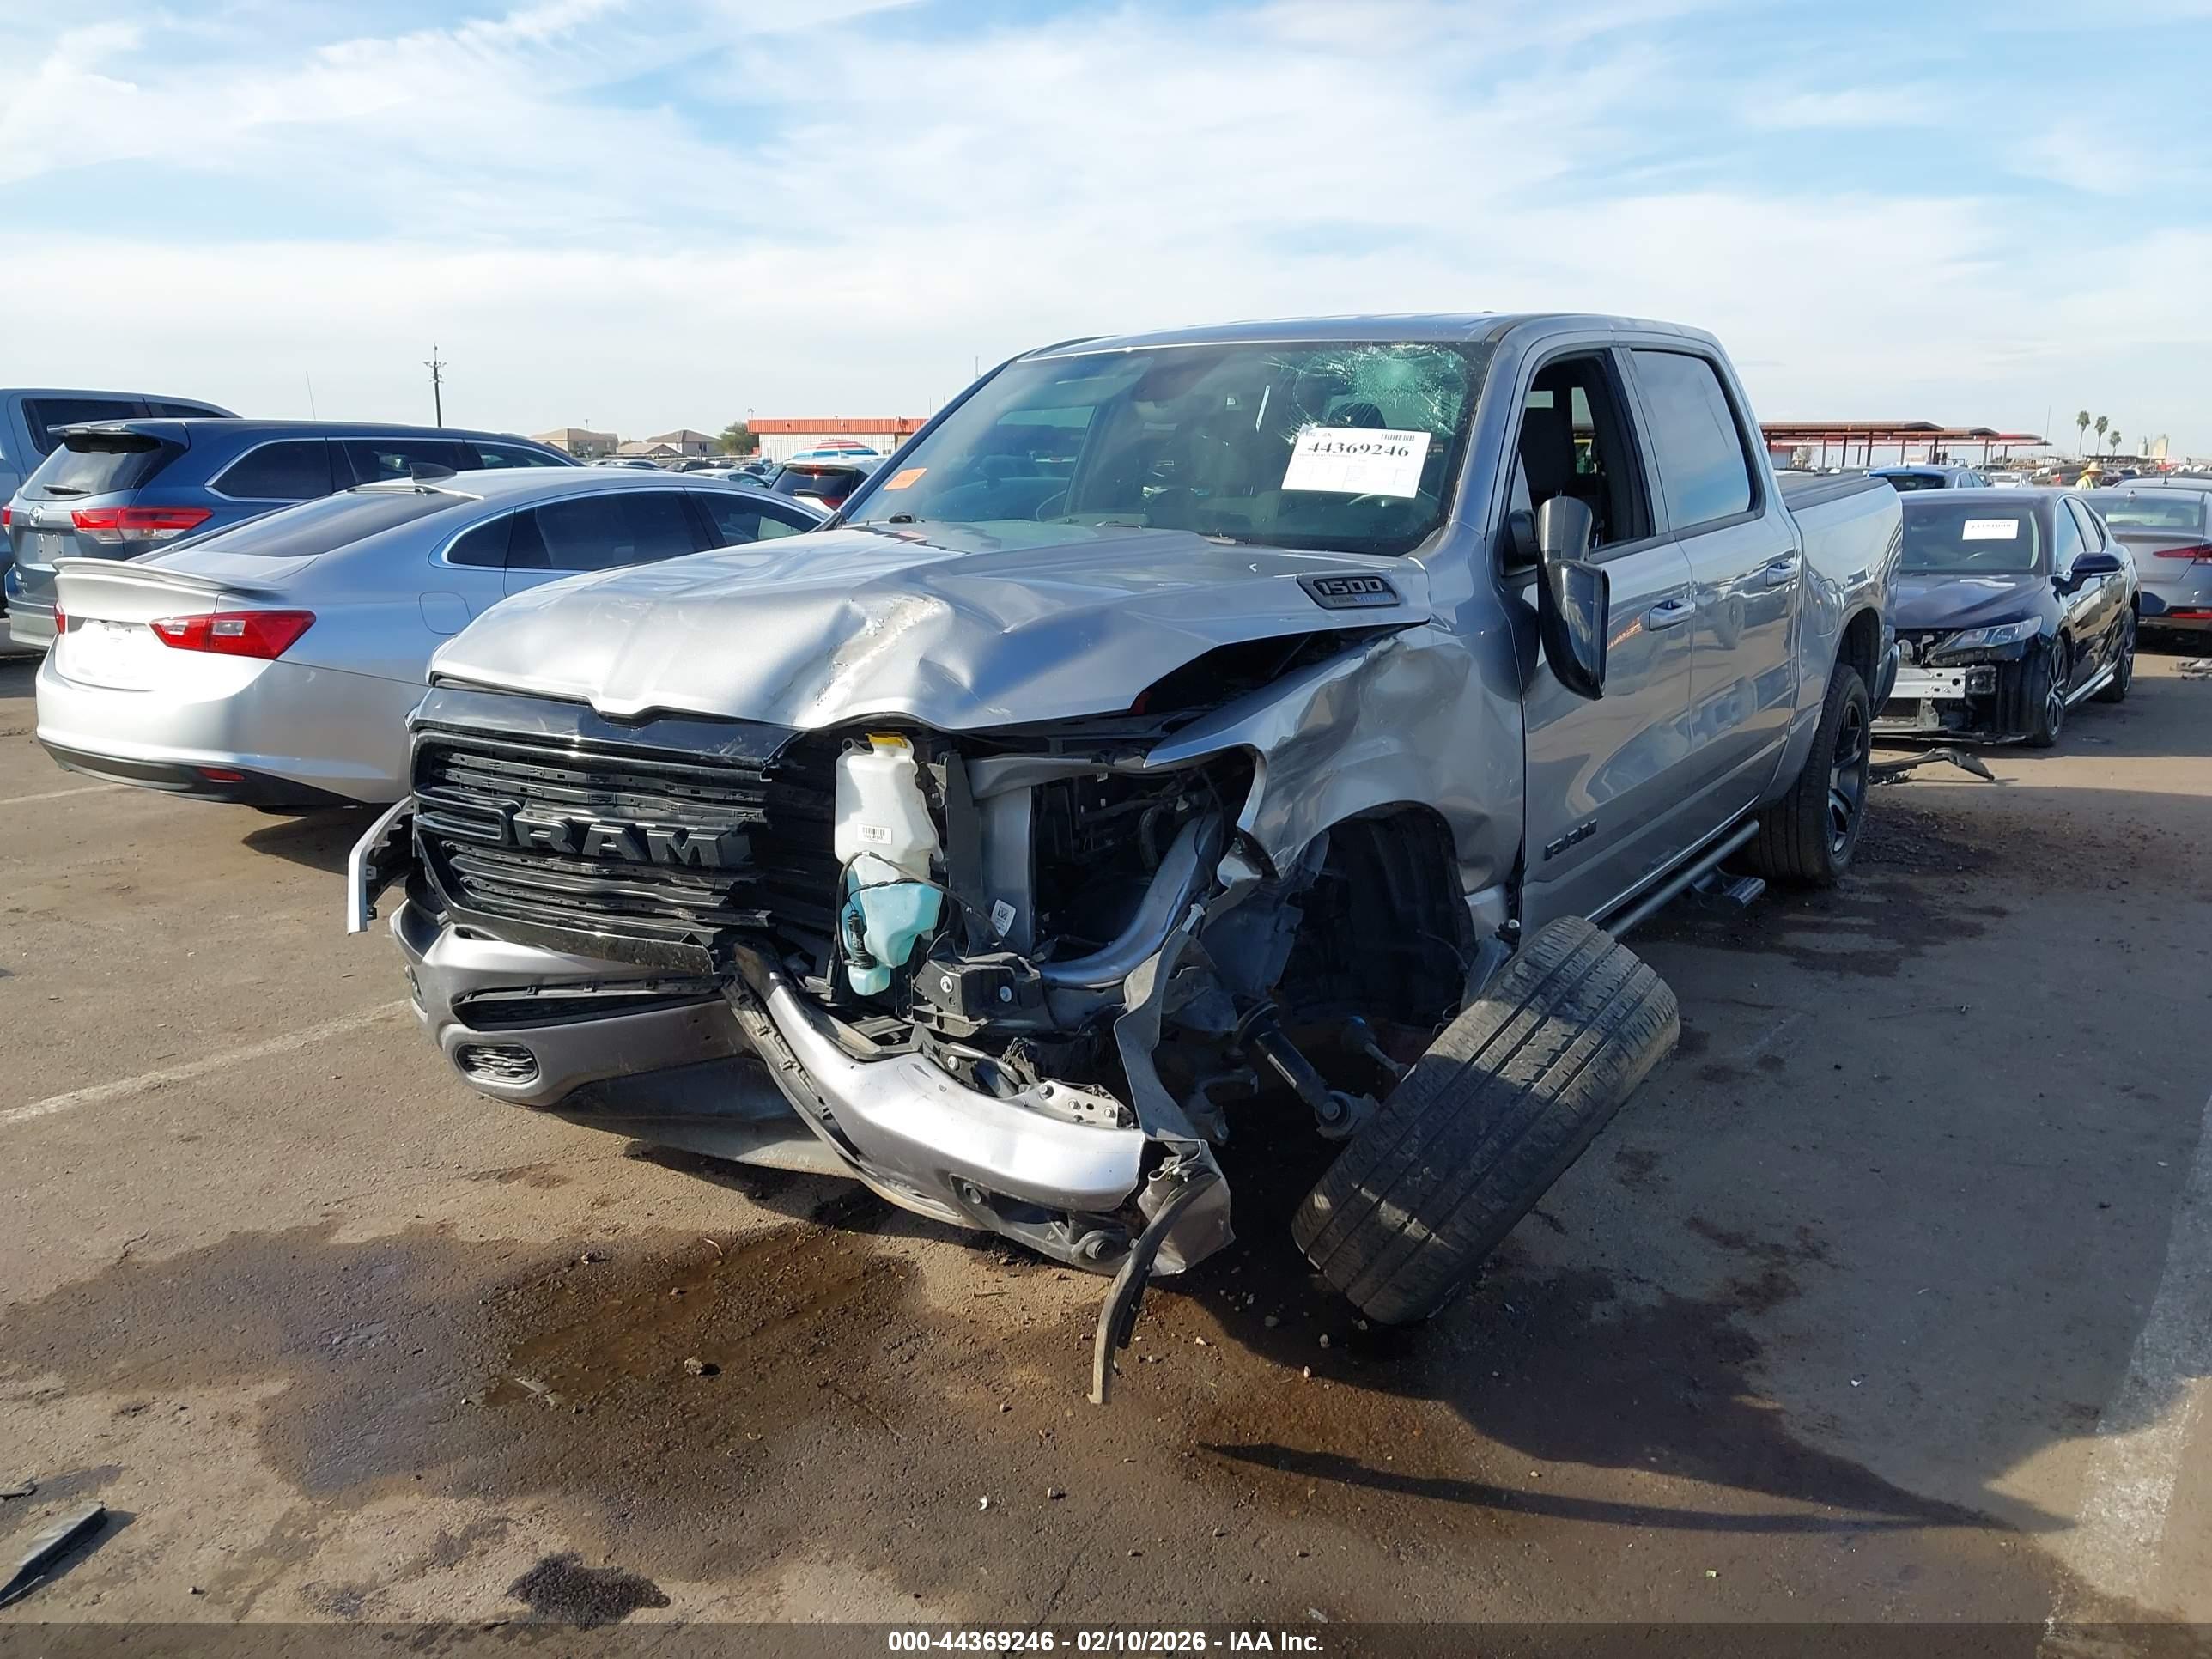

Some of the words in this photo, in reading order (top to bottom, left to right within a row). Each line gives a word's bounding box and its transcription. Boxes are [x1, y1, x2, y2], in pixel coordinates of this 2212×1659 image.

[1307, 441, 1410, 458] 44369246
[1317, 579, 1384, 595] 1500
[513, 811, 744, 866] RAM
[1544, 818, 1598, 861] RAM
